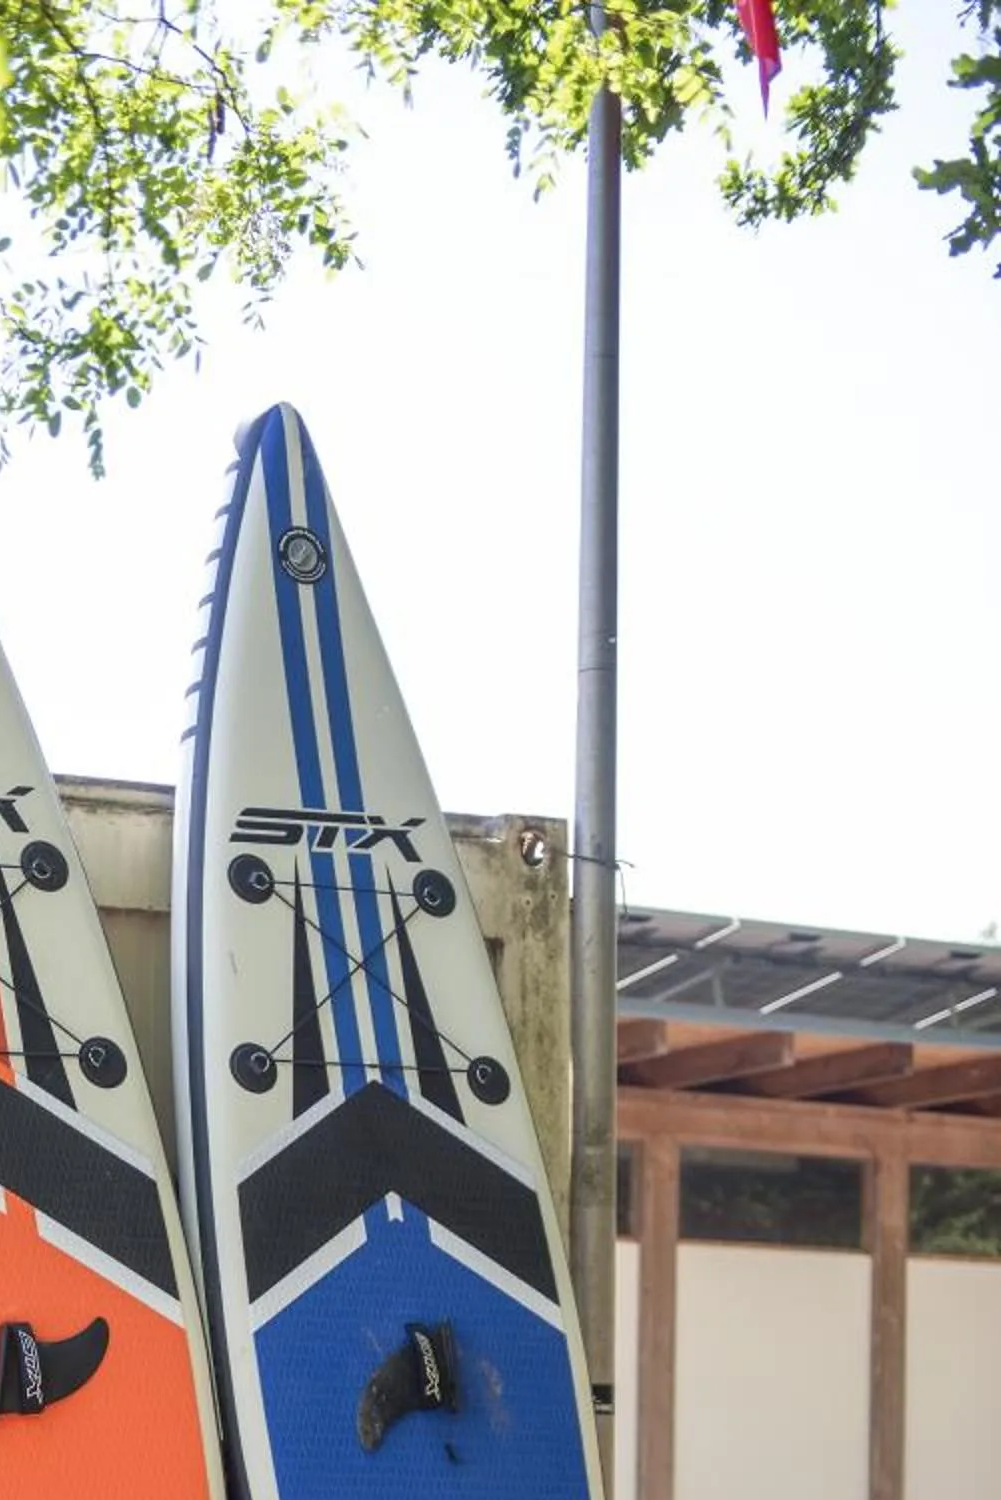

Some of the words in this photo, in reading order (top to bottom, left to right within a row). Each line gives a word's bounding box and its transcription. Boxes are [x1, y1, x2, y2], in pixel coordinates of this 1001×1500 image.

[229, 807, 427, 863] STX
[19, 1330, 44, 1404] STX
[415, 1331, 440, 1402] STX
